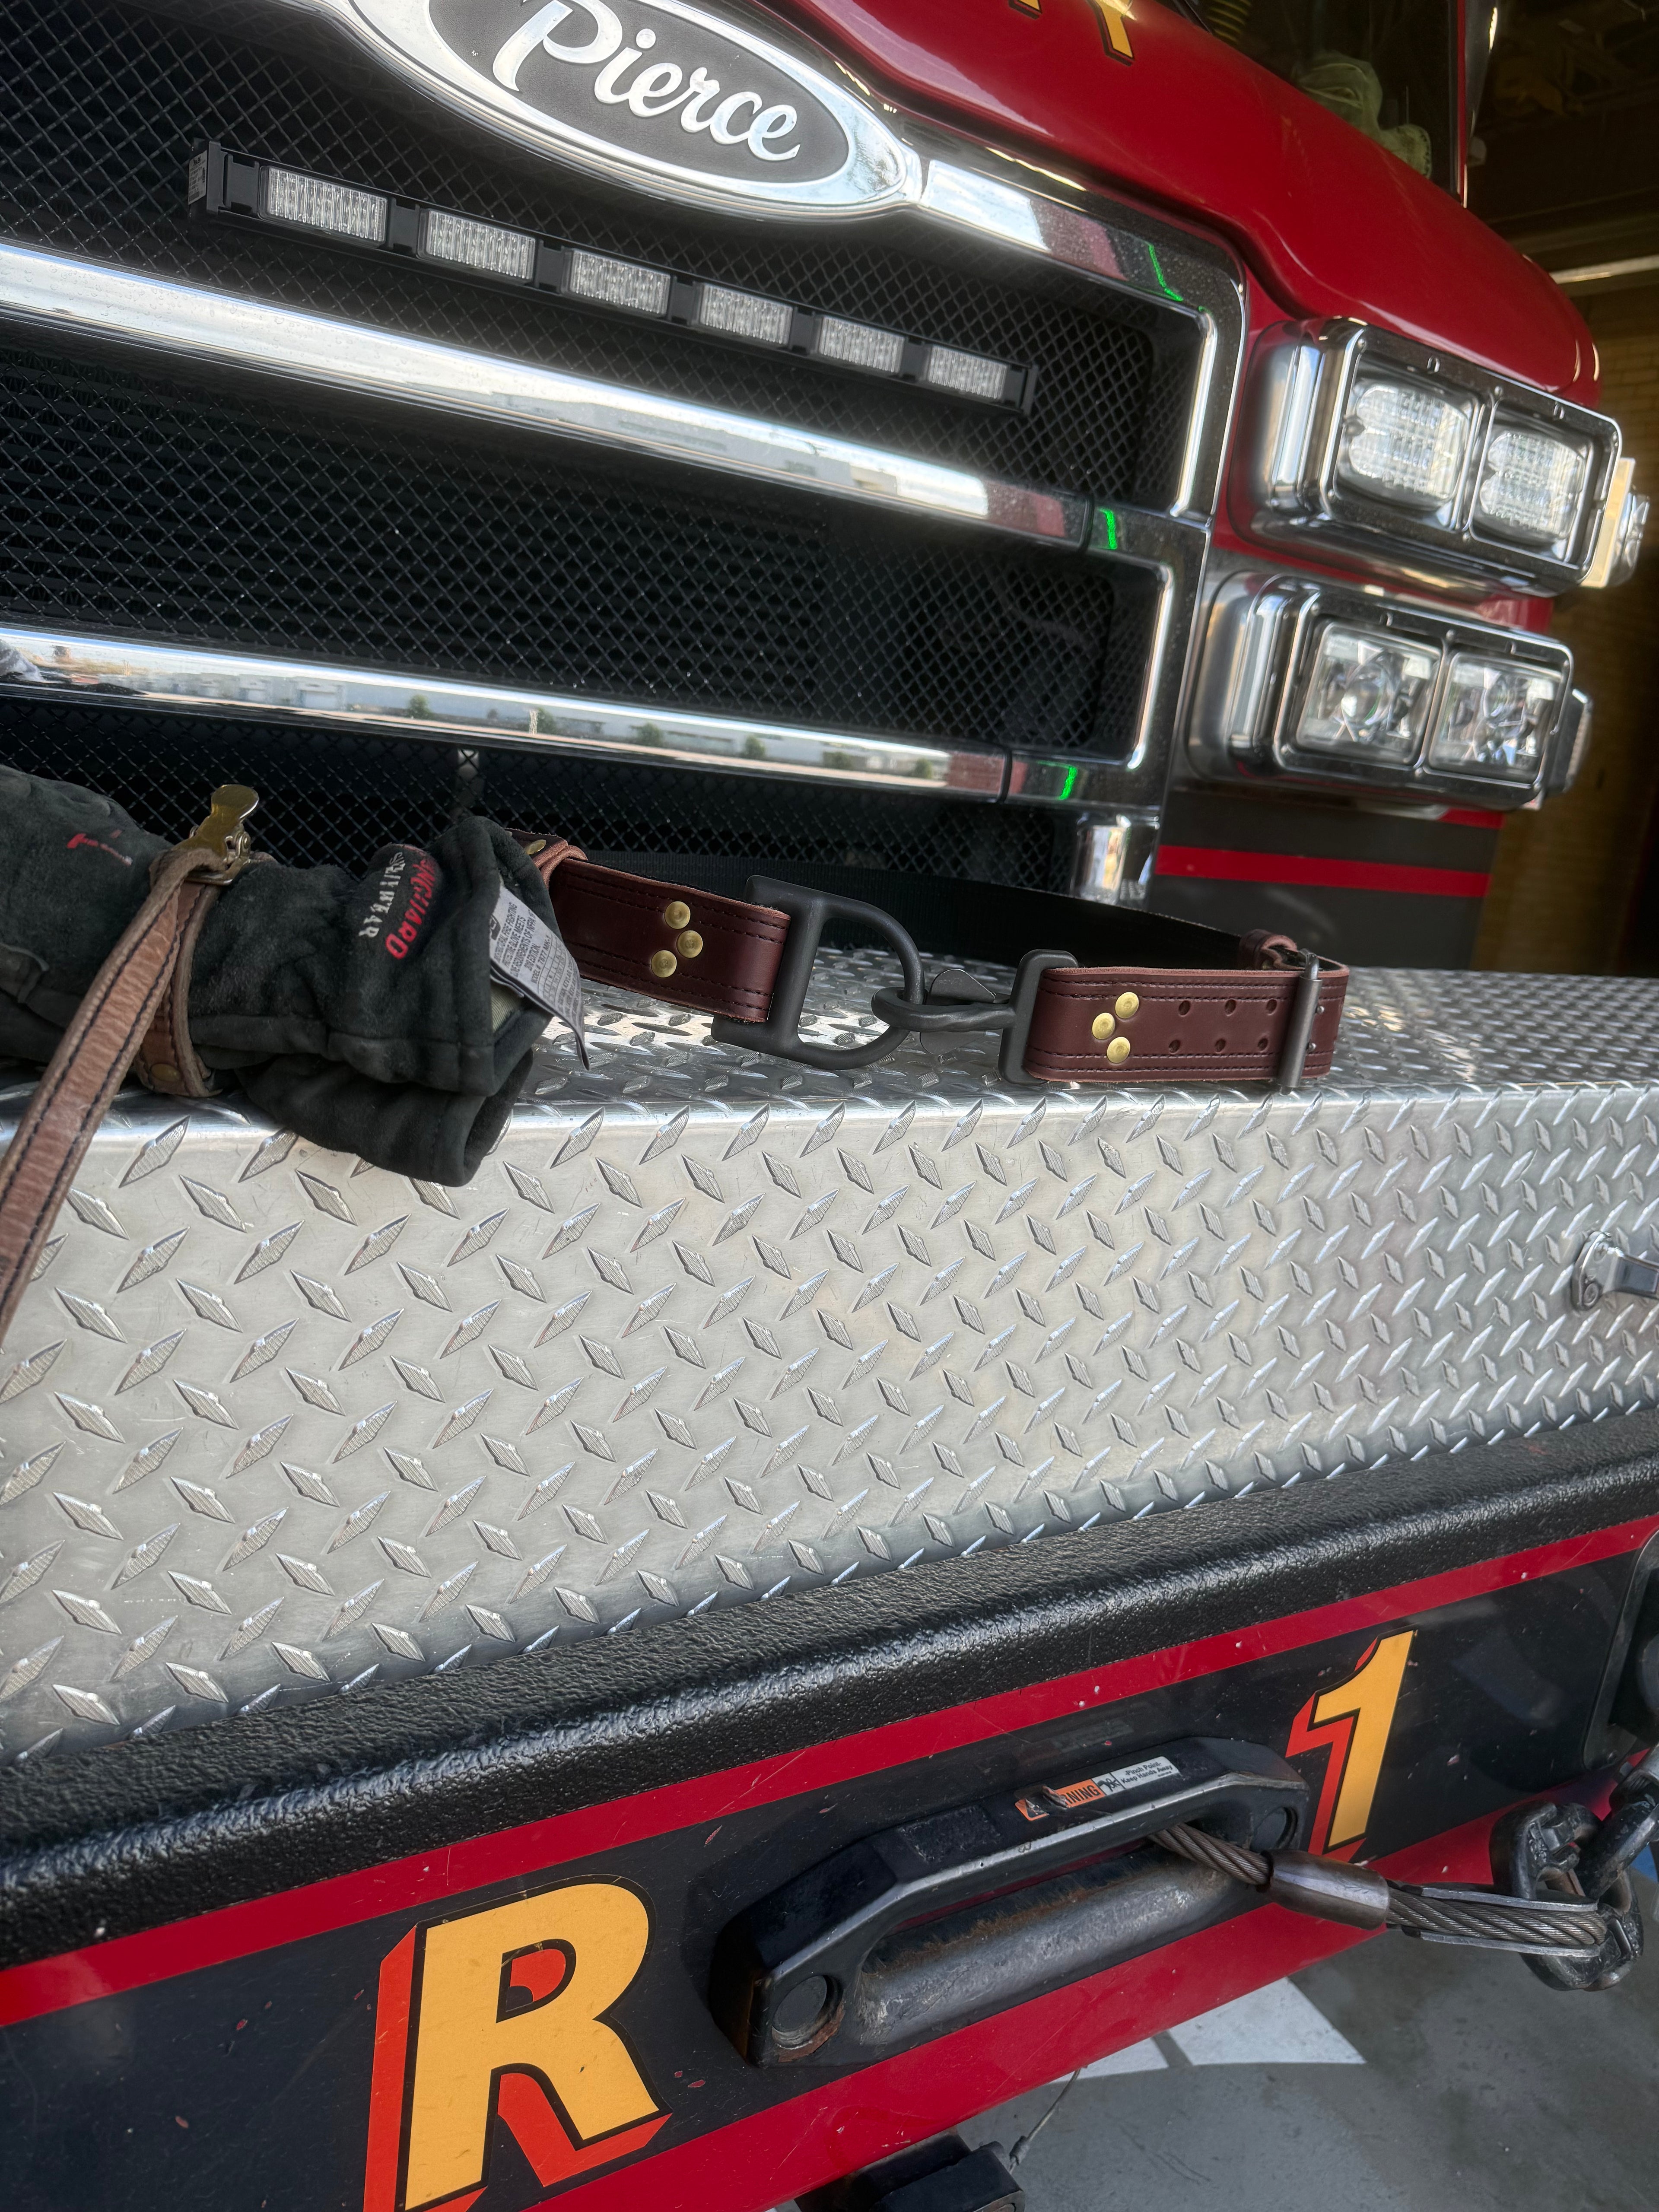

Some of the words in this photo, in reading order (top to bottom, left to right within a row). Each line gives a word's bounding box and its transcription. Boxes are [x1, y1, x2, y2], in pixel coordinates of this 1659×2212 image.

[493, 0, 801, 162] Pierce
[505, 902, 517, 927] FIGHTING
[526, 916, 536, 933] NFPA
[501, 922, 512, 938] FIRE
[513, 915, 526, 936] MEETS
[524, 928, 533, 941] OF
[508, 930, 521, 948] GLOVE
[1121, 1773, 1138, 1784] Keep
[1138, 1769, 1157, 1780] Hands
[1156, 1764, 1173, 1773] Away
[1061, 1784, 1101, 1805] RNING
[394, 1874, 671, 2212] R
[1306, 1628, 1417, 1852] 1
